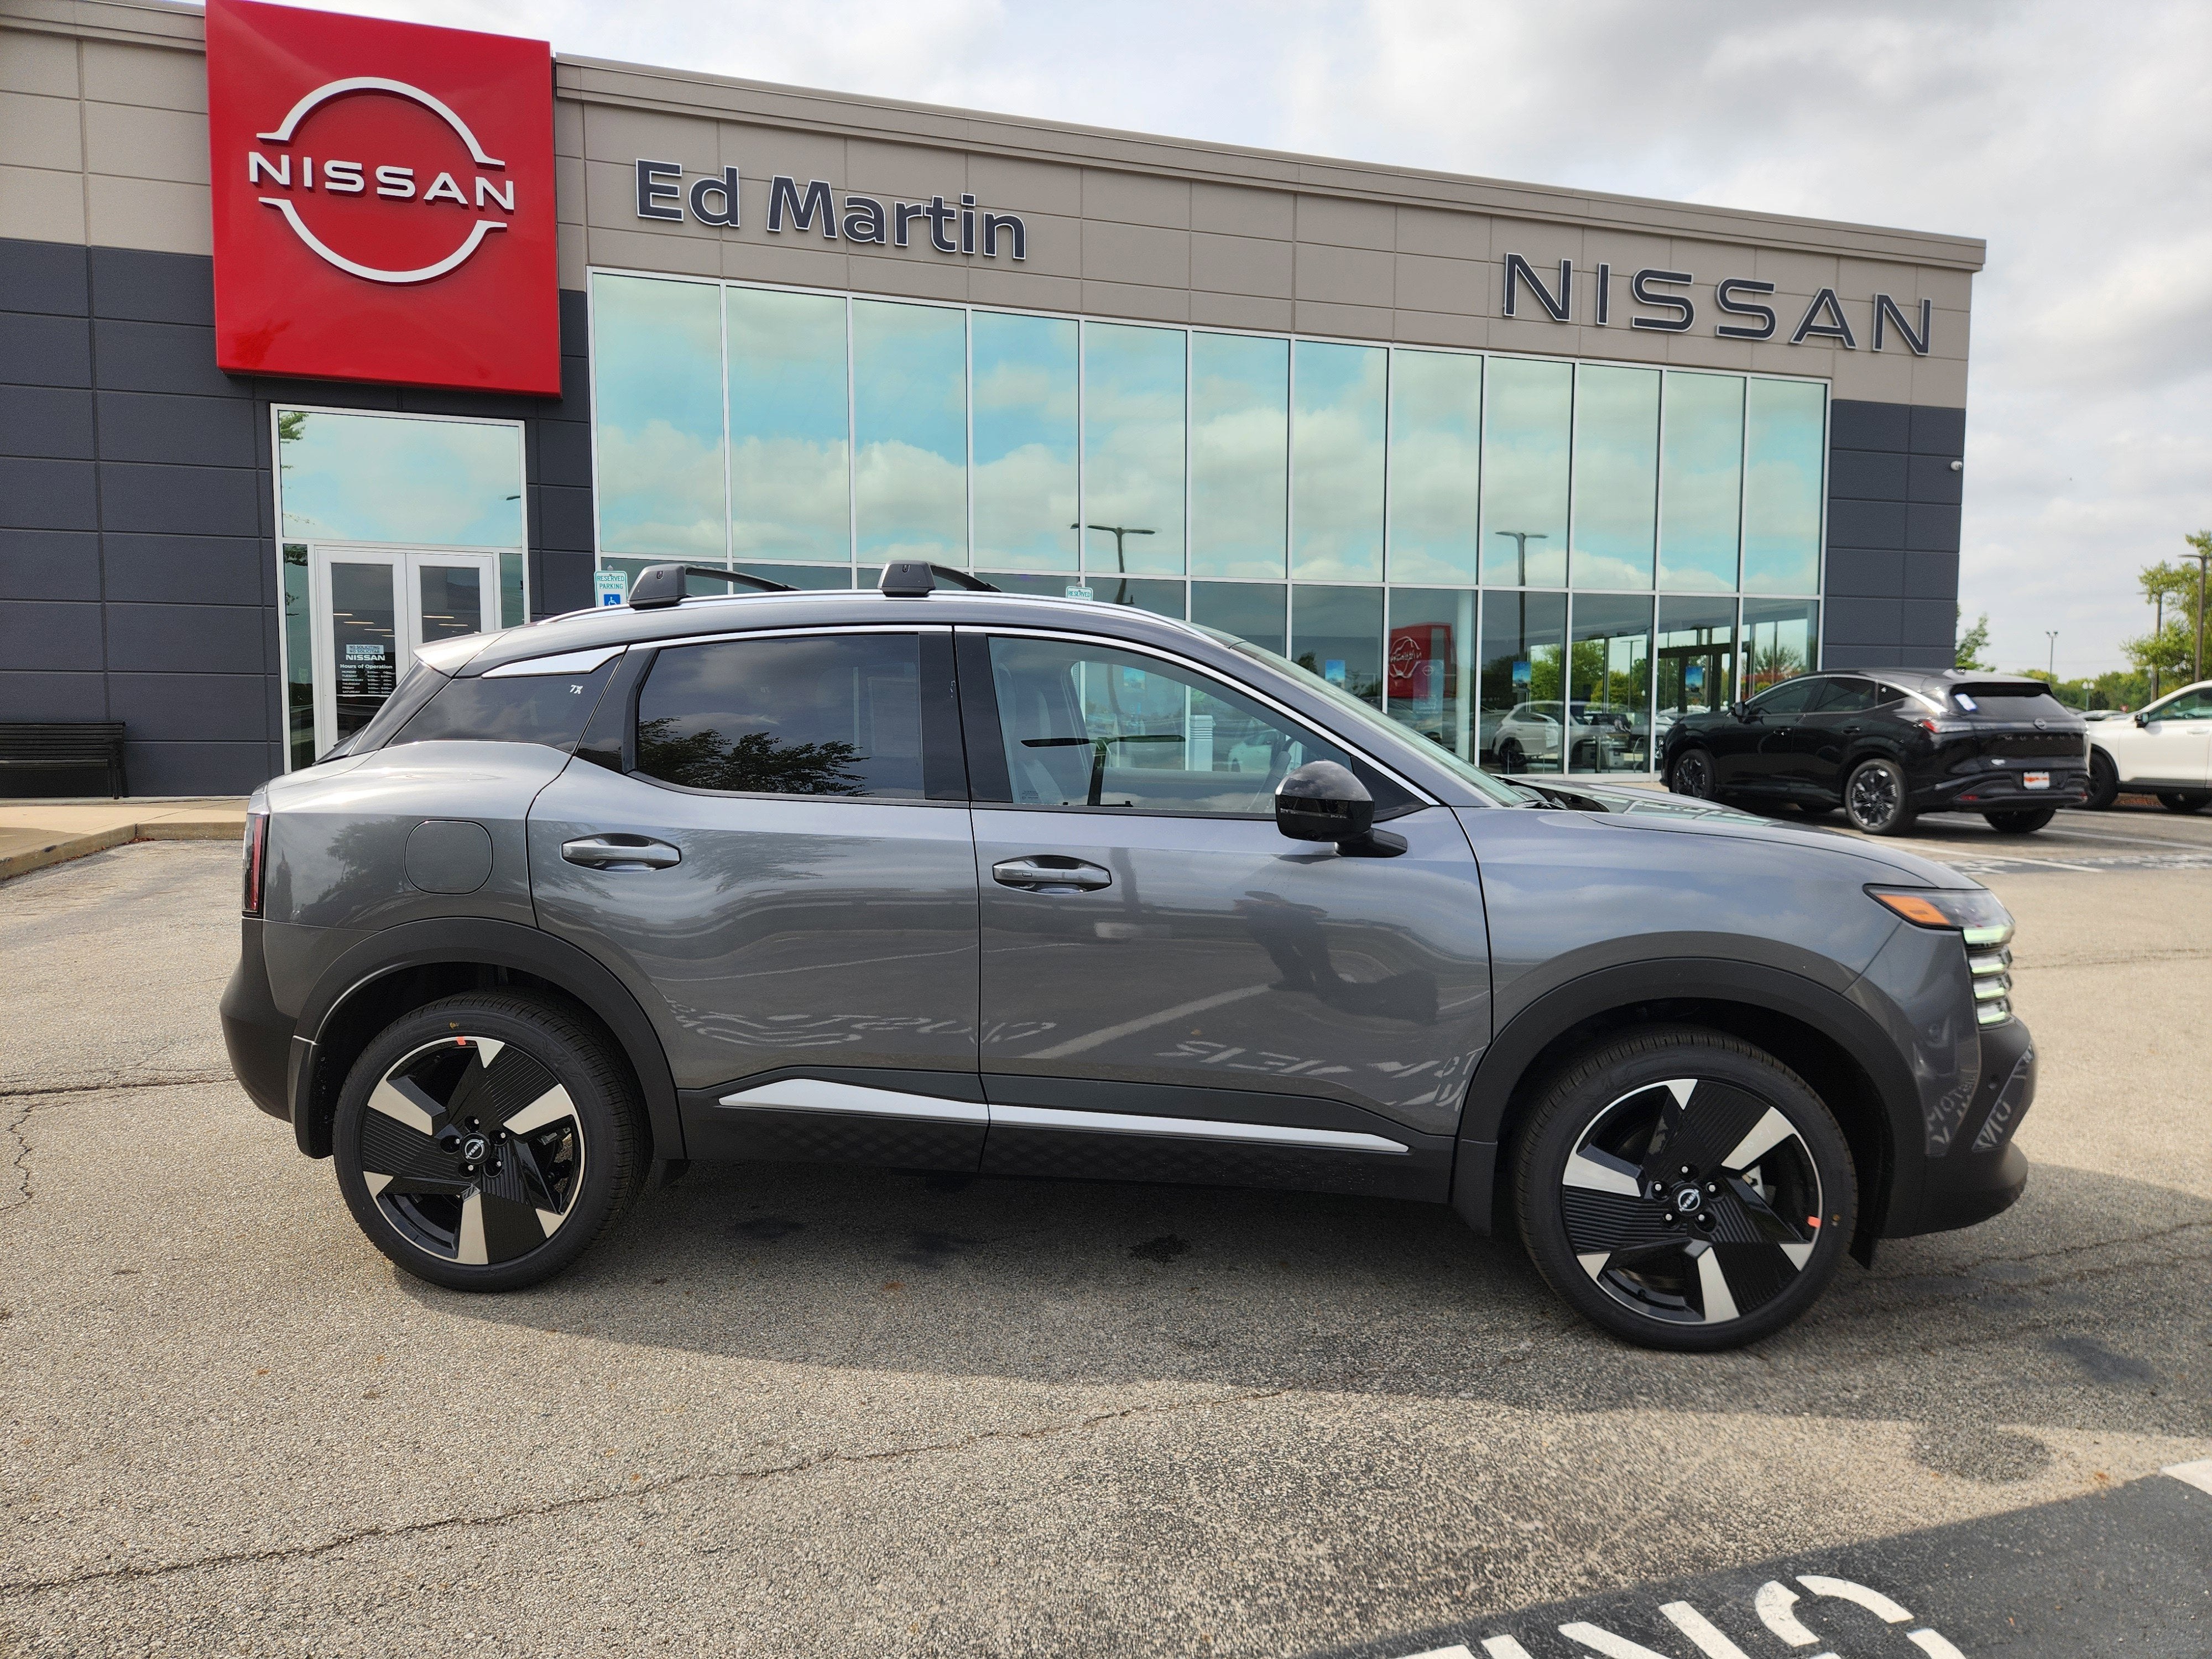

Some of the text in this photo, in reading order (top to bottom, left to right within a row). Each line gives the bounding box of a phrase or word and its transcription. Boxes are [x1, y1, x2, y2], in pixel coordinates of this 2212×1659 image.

[249, 152, 514, 211] NISSAN
[635, 158, 1027, 260] Ed Martin
[1503, 252, 1932, 356] NISSAN
